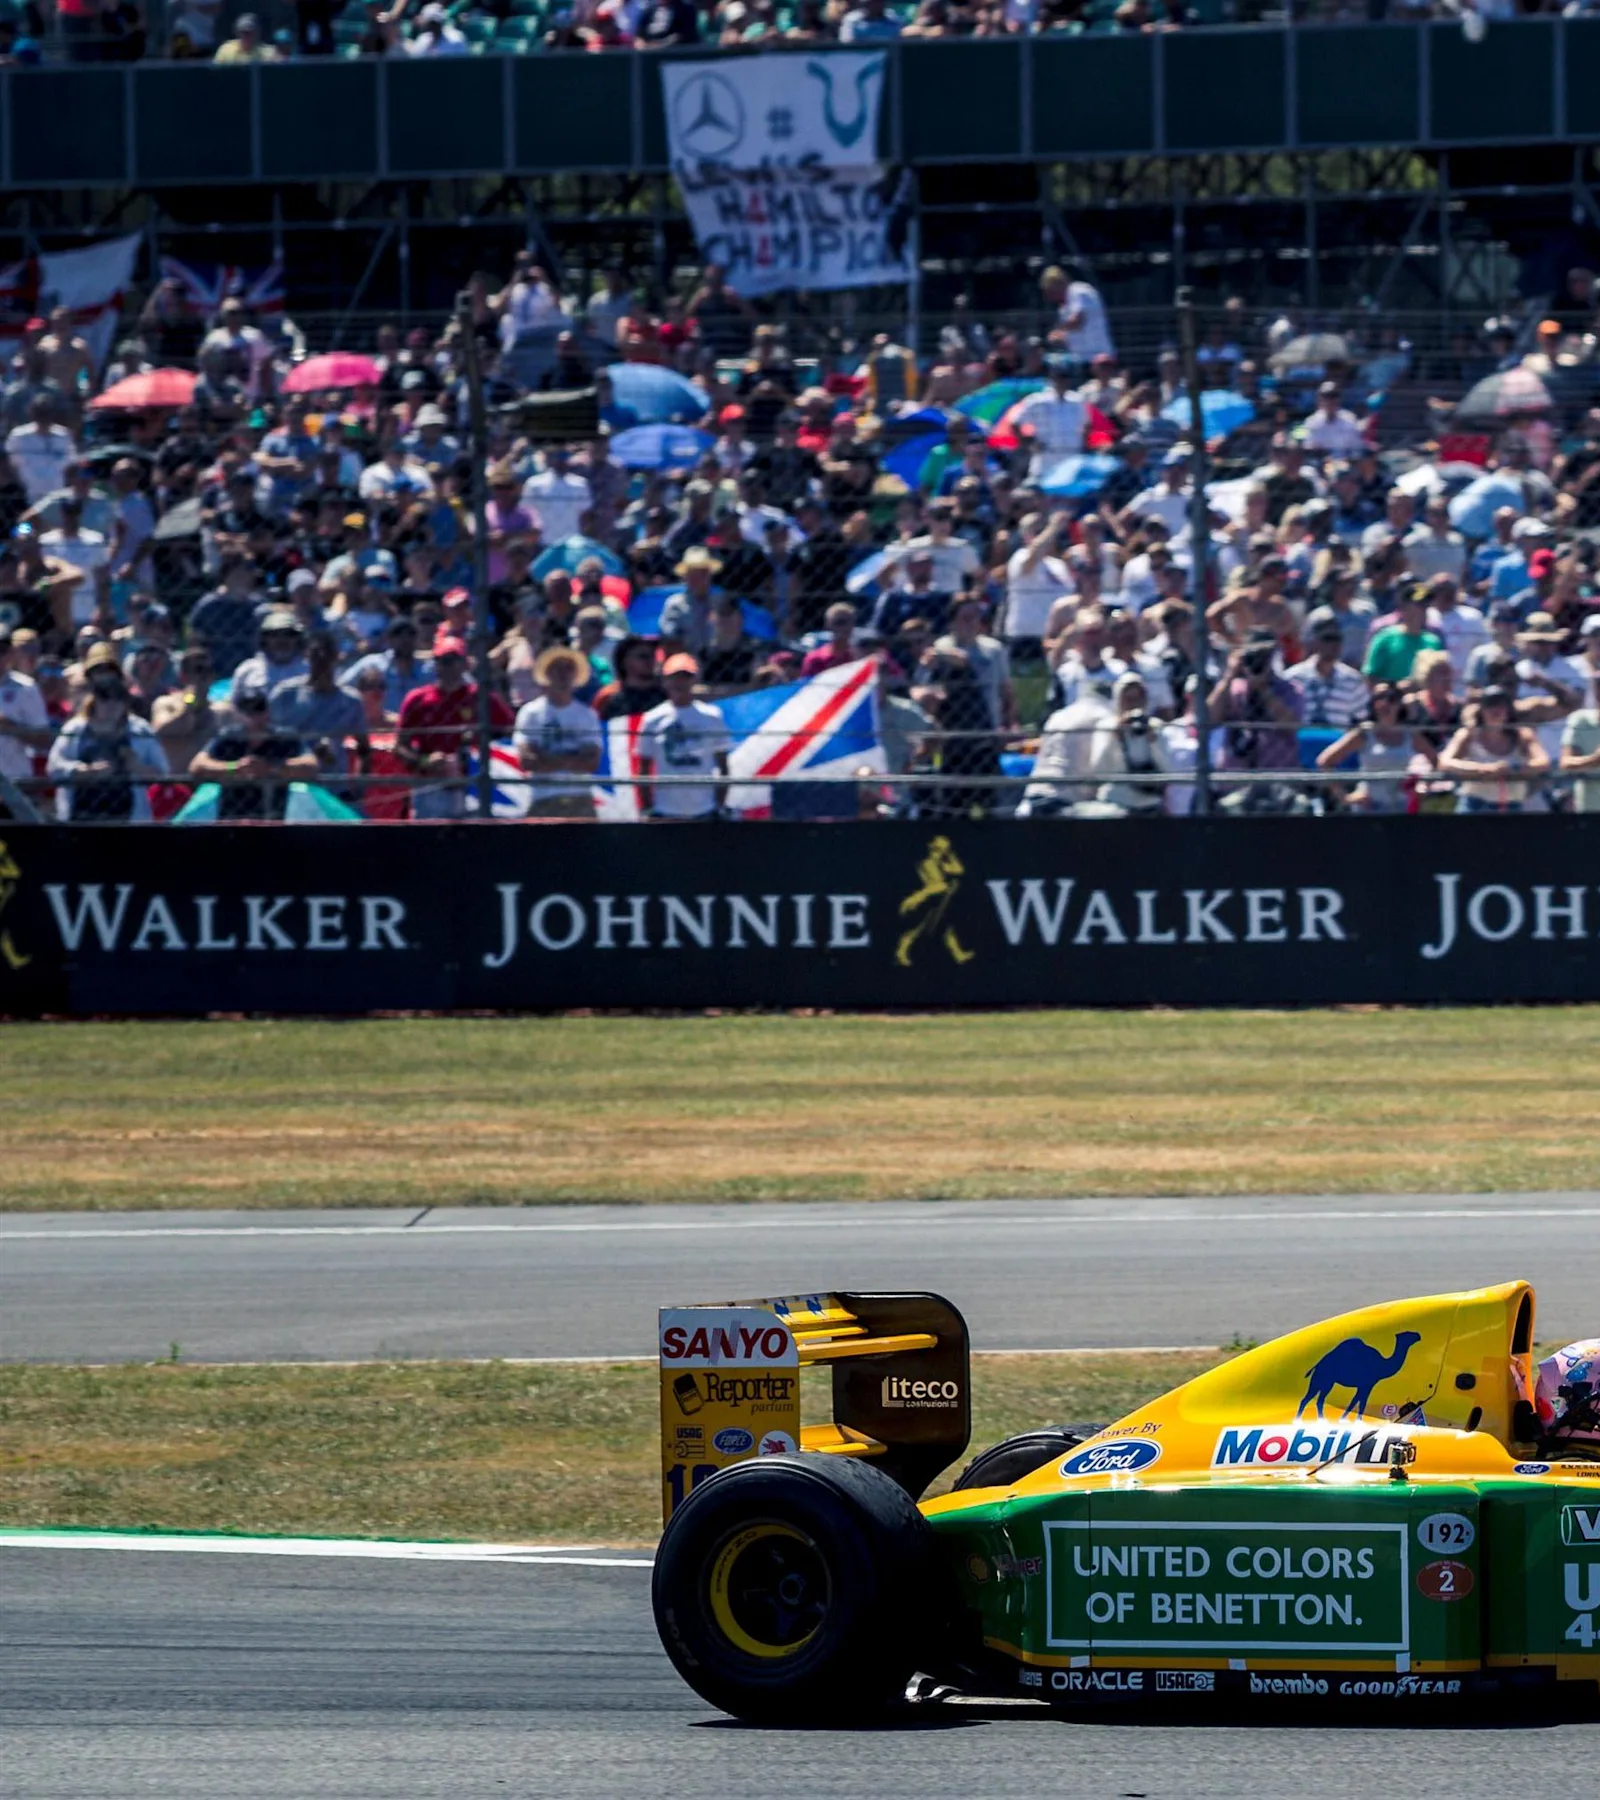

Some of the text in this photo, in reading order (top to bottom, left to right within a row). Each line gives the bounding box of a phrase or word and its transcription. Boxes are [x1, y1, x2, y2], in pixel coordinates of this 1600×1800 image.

[714, 184, 882, 226] HAMILTO
[44, 883, 407, 951] WALKER
[484, 878, 1347, 967] JOHNNIE WALKER
[662, 1327, 788, 1359] SANYO
[703, 1372, 795, 1407] Reporter
[1077, 1444, 1141, 1472] Ford
[1216, 1428, 1349, 1465] Mobil
[1074, 1546, 1210, 1577] UNITED
[1226, 1547, 1374, 1579] COLORS
[1438, 1570, 1455, 1592] 2
[1086, 1592, 1364, 1626] OF BENETTON.
[1051, 1671, 1143, 1690] ORACLE
[1157, 1672, 1196, 1690] USAG
[1250, 1672, 1329, 1694] brembo
